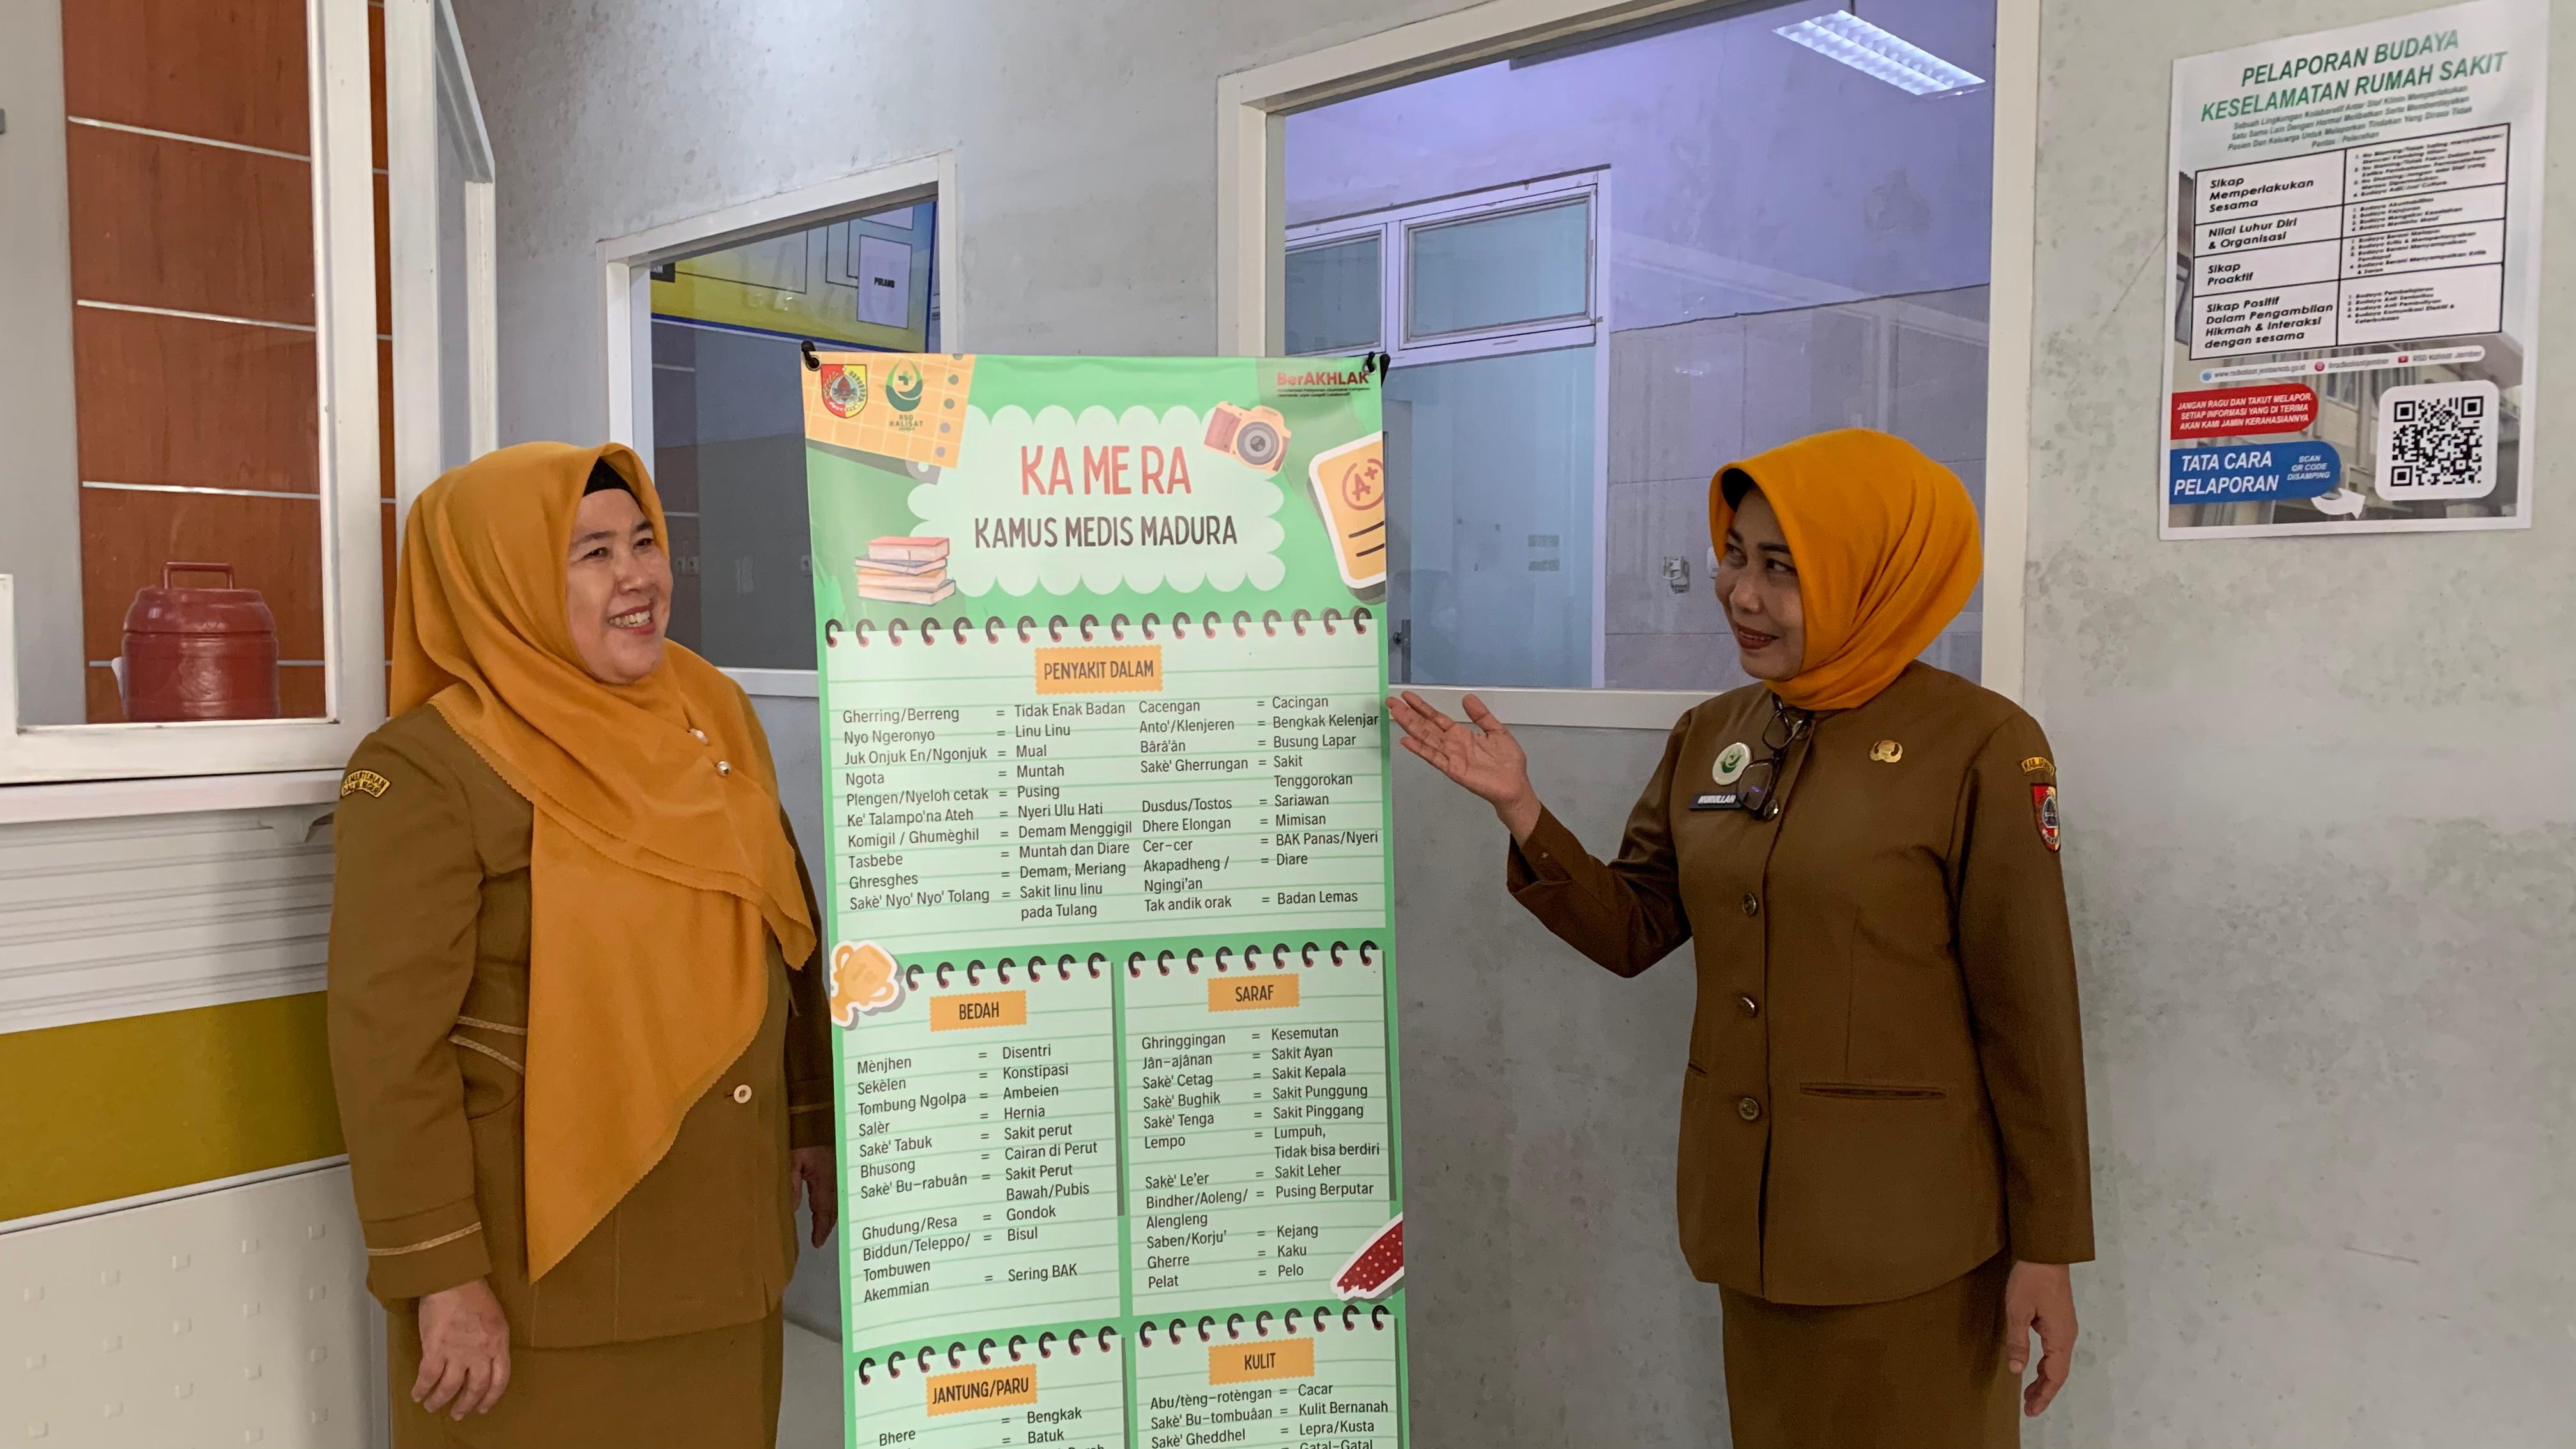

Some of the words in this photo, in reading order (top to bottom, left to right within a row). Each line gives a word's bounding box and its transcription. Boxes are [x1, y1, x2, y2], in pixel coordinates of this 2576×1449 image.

[2241, 48, 2369, 87] PELAPORAN
[2373, 29, 2459, 64] BUDAYA
[2201, 79, 2350, 122] KESELAMATAN
[2355, 64, 2432, 96] RUMAH
[2439, 51, 2508, 81] SAKIT
[2209, 179, 2314, 201] Memperlakukan
[2210, 178, 2244, 189] Sikap
[2209, 199, 2259, 213] Sesama
[2208, 226, 2235, 238] Nilai
[2239, 222, 2273, 234] Luhur
[2276, 217, 2297, 229] Diri
[2208, 241, 2216, 250] &
[2220, 231, 2287, 248] Organisasi
[2208, 263, 2241, 274] Sikap
[2207, 272, 2254, 286] Proaktif
[2206, 302, 2239, 313] Sikap
[2243, 296, 2280, 309] Positif
[2206, 314, 2245, 325] Dalam
[2250, 303, 2333, 320] Pengambilan
[2205, 325, 2251, 337] Hikmah
[2255, 323, 2263, 331] &
[2268, 316, 2321, 330] Interaksi
[2205, 337, 2252, 349] dengan
[2256, 332, 2304, 344] sesama
[1276, 372, 1369, 385] BerAKHLAK
[2177, 402, 2207, 410] JANGAN
[2207, 399, 2229, 408] RAGU
[2248, 395, 2271, 405] TAKUT
[2181, 412, 2206, 420] SETIAP
[2207, 408, 2247, 418] INFORMASI
[2249, 406, 2269, 415] YANG
[2280, 404, 2308, 413] TERIMA
[2180, 422, 2200, 430] AKAN
[2202, 420, 2220, 428] KAMI
[2221, 418, 2244, 427] JAMIN
[2245, 414, 2309, 425] KERAHASIANNYA
[2182, 454, 2220, 471] TATA
[2224, 451, 2272, 470] CARA
[1022, 445, 1073, 495] KA
[1084, 445, 1131, 495] ME
[1141, 445, 1192, 494] RA
[2287, 471, 2331, 480] DISAMPING
[1352, 466, 1378, 502] A+
[2174, 475, 2279, 496] PELAPORAN
[975, 517, 1059, 548] KAMUS
[1065, 516, 1134, 547] MEDIS
[1140, 515, 1238, 546] MADURA
[1044, 661, 1107, 680] PENYAKIT
[1110, 659, 1154, 678] DALAM
[1014, 703, 1049, 717] Tidak
[1052, 702, 1083, 716] Enak
[1085, 702, 1125, 715] Badan
[1138, 700, 1200, 715] Cacengan
[1272, 696, 1329, 711] Cacingan
[843, 708, 959, 724] Gherring/Berreng
[1273, 714, 1326, 731] Bengkak
[1328, 713, 1379, 728] Kelenjar
[844, 731, 869, 747] Nyo
[872, 730, 935, 746] Ngeronyo
[1015, 725, 1041, 738] Linu
[1045, 724, 1071, 737] Linu
[1273, 735, 1319, 750] Busung
[1322, 734, 1357, 749] Lapar
[845, 751, 866, 765] Juk
[868, 749, 907, 766] Onjuk
[910, 746, 987, 764] En/Ngonjuk
[1016, 744, 1047, 758] Mual
[1016, 763, 1064, 778] Muntah
[846, 772, 884, 788] Ngota
[1273, 772, 1353, 790] Tenggorokan
[847, 788, 950, 808] Plengen/Nyeloh
[953, 786, 989, 801] cetak
[1017, 784, 1060, 800] Pusing
[1274, 793, 1330, 807] Sariawan
[1018, 805, 1051, 821] Nyeri
[1054, 803, 1075, 816] Ulu
[1078, 802, 1103, 816] Hati
[1142, 797, 1232, 813] Dusdus/Tostos
[1142, 819, 1179, 833] Dhere
[1182, 818, 1231, 832] Elongan
[1275, 813, 1326, 827] Mimisan
[1018, 825, 1066, 838] Demam
[1070, 820, 1132, 838] Menggigil
[1019, 843, 1067, 859] Muntah
[1070, 843, 1094, 856] dan
[1097, 841, 1130, 855] Diare
[848, 853, 903, 869] Tasbebe
[1020, 866, 1071, 878] Demam,
[1075, 862, 1126, 877] Meriang
[849, 873, 918, 889] Ghresghes
[1144, 898, 1165, 912] Tak
[1168, 896, 1202, 911] andik
[1204, 895, 1232, 908] orak
[1277, 891, 1316, 905] Badan
[1319, 891, 1358, 903] Lemas
[1235, 984, 1274, 1002] SARAF
[958, 1001, 999, 1020] BEDAH
[1142, 1034, 1226, 1050] Ghringgingan
[1271, 1027, 1338, 1041] Kesemutan
[1002, 1043, 1051, 1059] Disentri
[1002, 1062, 1068, 1080] Konstipasi
[1272, 1066, 1302, 1080] Sakit
[1305, 1064, 1346, 1080] Kepala
[1003, 1085, 1059, 1100] Ambeien
[1273, 1085, 1302, 1100] Sakit
[1305, 1085, 1368, 1100] Punggung
[857, 1098, 916, 1116] Tombung
[920, 1092, 967, 1110] Ngolpa
[1004, 1107, 1045, 1120] Hernia
[1144, 1136, 1186, 1150] Lempo
[861, 1160, 916, 1179] Bhusong
[1006, 1204, 1057, 1222] Gondok
[1146, 1213, 1208, 1230] Alengleng
[1008, 1226, 1038, 1242] Bisul
[1277, 1224, 1319, 1239] Kejang
[1277, 1243, 1307, 1258] Kaku
[1147, 1255, 1190, 1269] Gherre
[1278, 1263, 1304, 1277] Pelo
[862, 1261, 930, 1282] Tombuwen
[1008, 1268, 1048, 1282] Sering
[1052, 1262, 1078, 1278] BAK
[1148, 1275, 1179, 1289] Pelat
[863, 1282, 930, 1303] Akemmian
[1244, 1352, 1276, 1371] KULIT
[931, 1376, 1029, 1405] JANTUNG/PARU
[1298, 1383, 1334, 1397] Cacar
[1027, 1406, 1082, 1425] Bengkak
[879, 1430, 916, 1447] Bhere
[1027, 1428, 1065, 1445] Batuk
